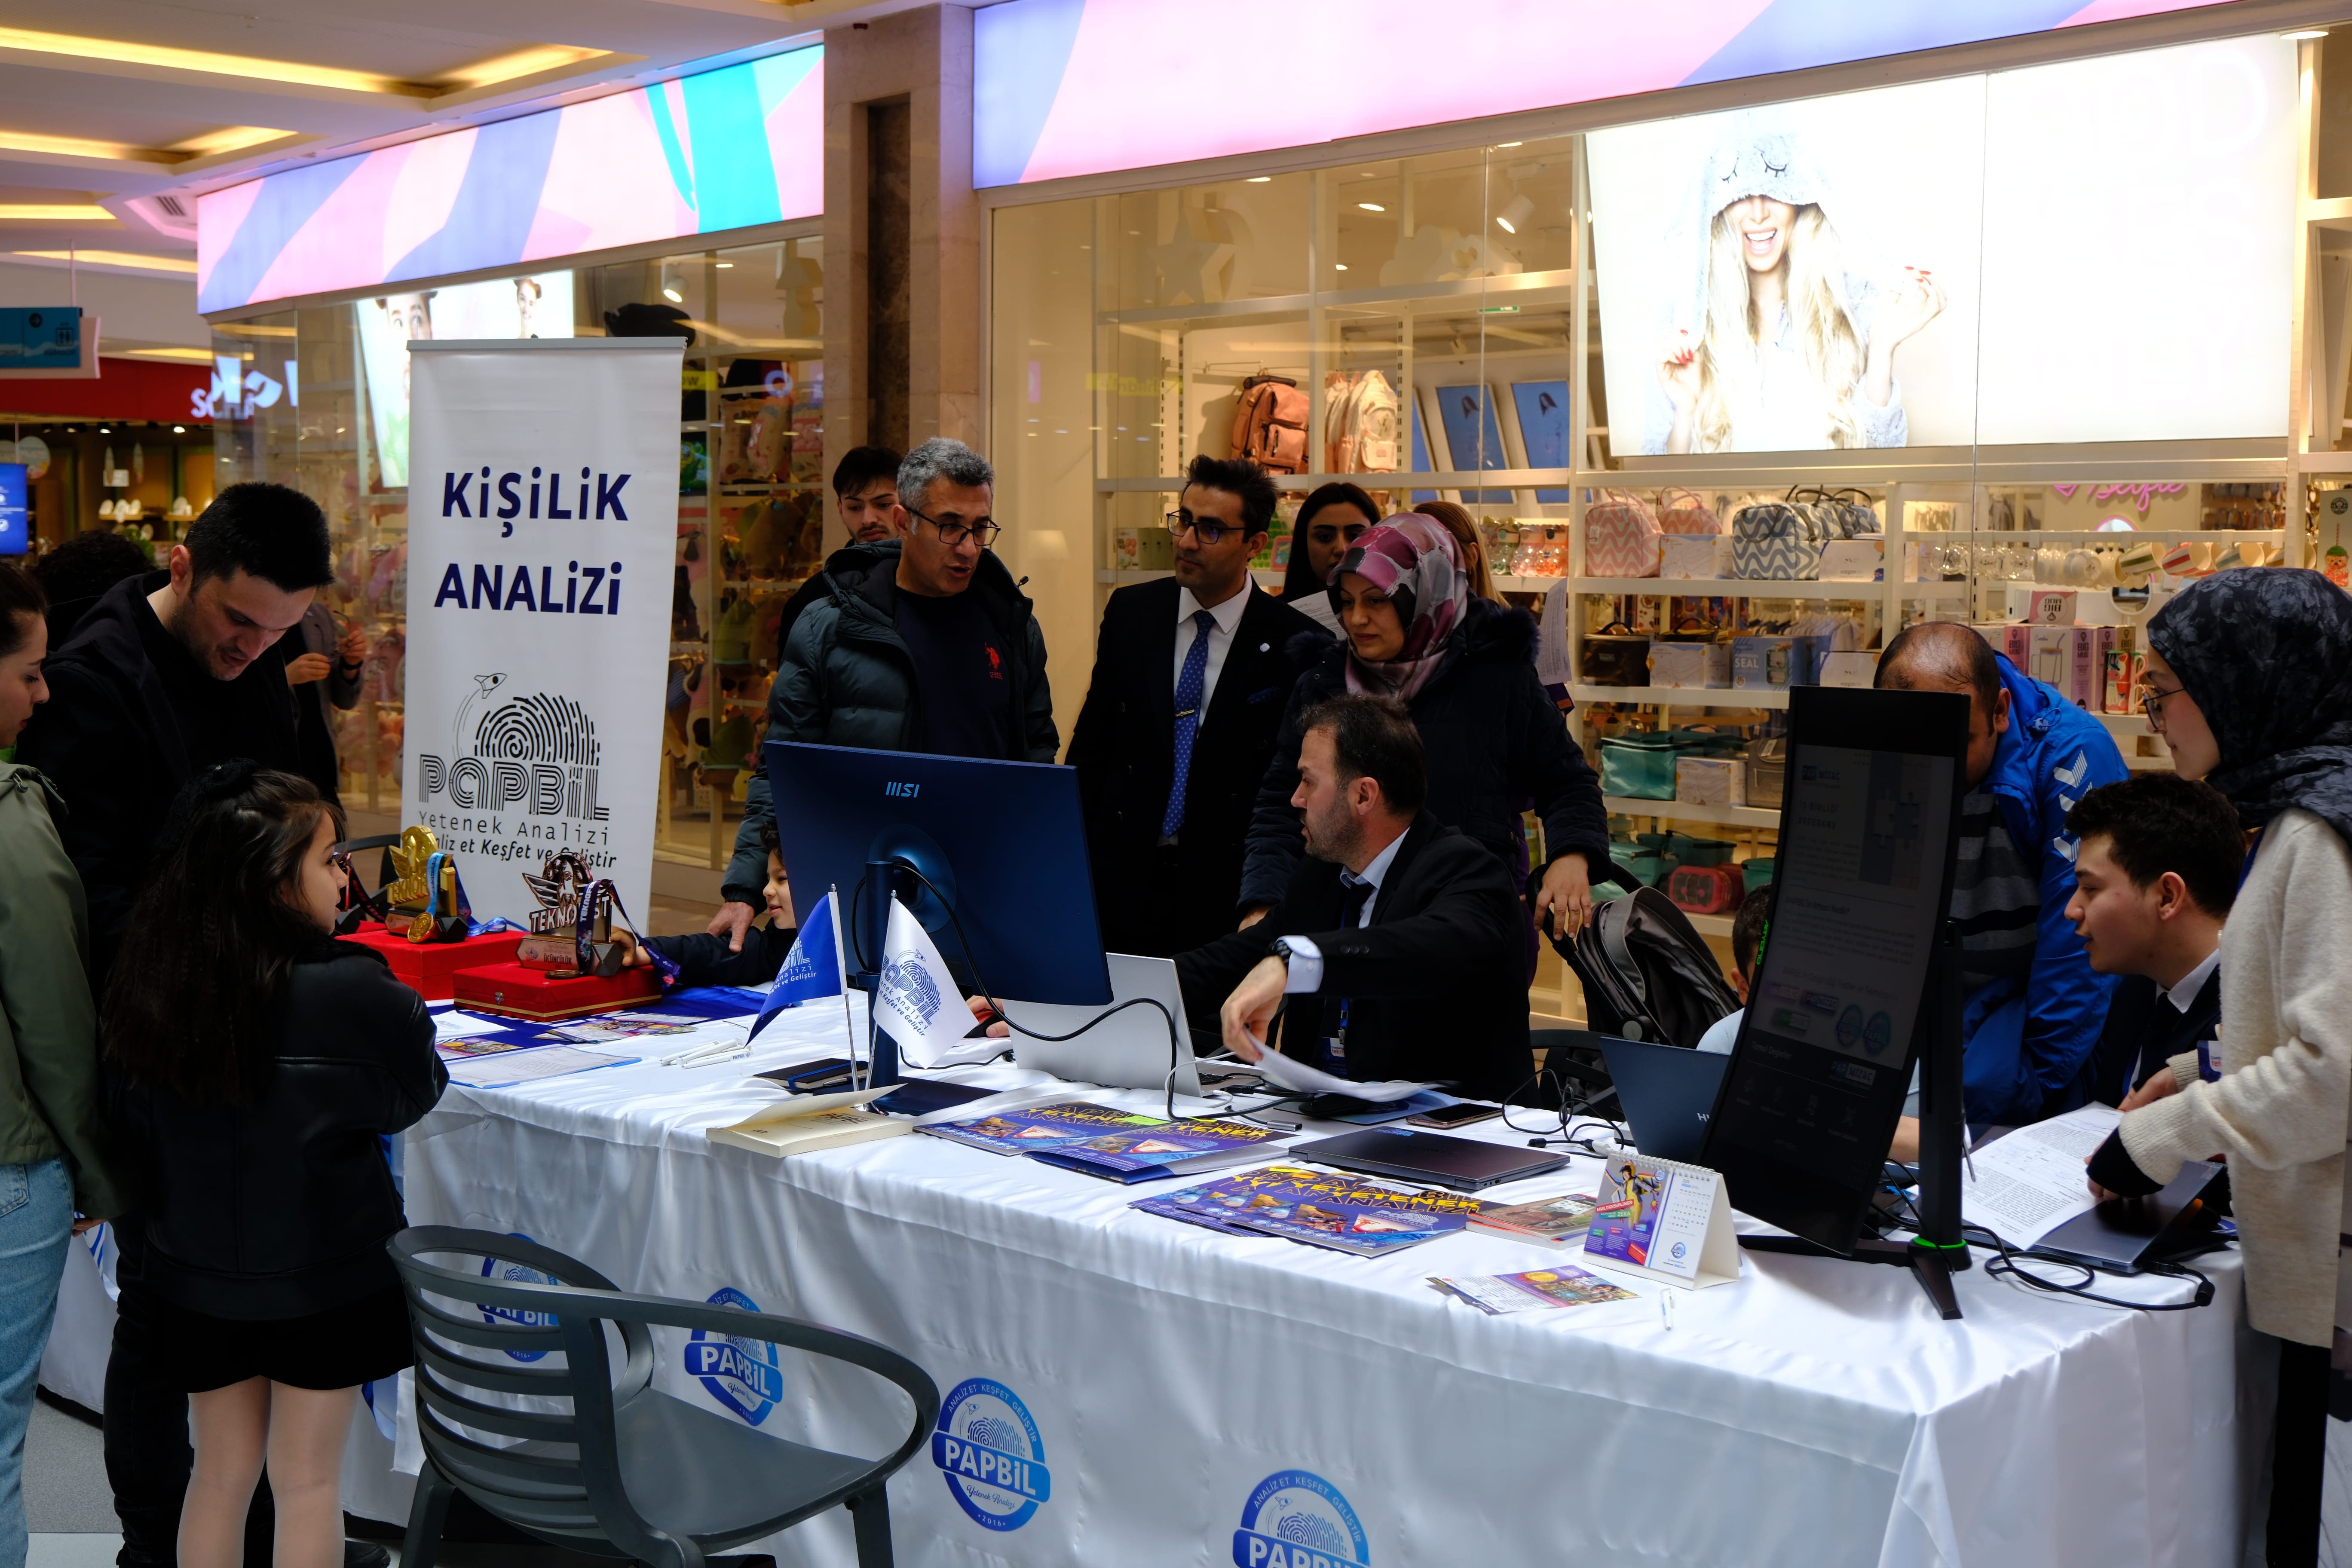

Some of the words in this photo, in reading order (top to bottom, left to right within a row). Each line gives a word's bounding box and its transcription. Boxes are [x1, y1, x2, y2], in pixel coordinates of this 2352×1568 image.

[2078, 643, 2089, 652] BIG
[2101, 641, 2113, 650] BIG
[1735, 658, 1759, 668] SEAL
[885, 781, 920, 798] MSI
[419, 811, 502, 835] Yetenek
[517, 821, 609, 846] Analizi
[461, 839, 475, 853] et
[481, 839, 531, 861] Keşfet
[790, 972, 817, 982] Geliştir
[895, 996, 928, 1030] Analizi
[904, 1014, 925, 1036] Geliştir
[1333, 1192, 1482, 1208] YETENEK
[722, 1293, 729, 1301] ET
[948, 1387, 968, 1414] ANALİZ
[969, 1384, 977, 1393] ET
[981, 1384, 1010, 1401] KEŞFET
[1012, 1401, 1037, 1443] GELİŞTİR
[967, 1484, 991, 1501] Yetenek
[992, 1494, 1016, 1510] Analizi
[1254, 1480, 1279, 1509] ANALİZ
[1279, 1476, 1289, 1487] ET
[1295, 1476, 1329, 1495] KEŞFET
[1332, 1496, 1362, 1543] GELİŞTİR
[982, 1515, 1001, 1527] 2016
